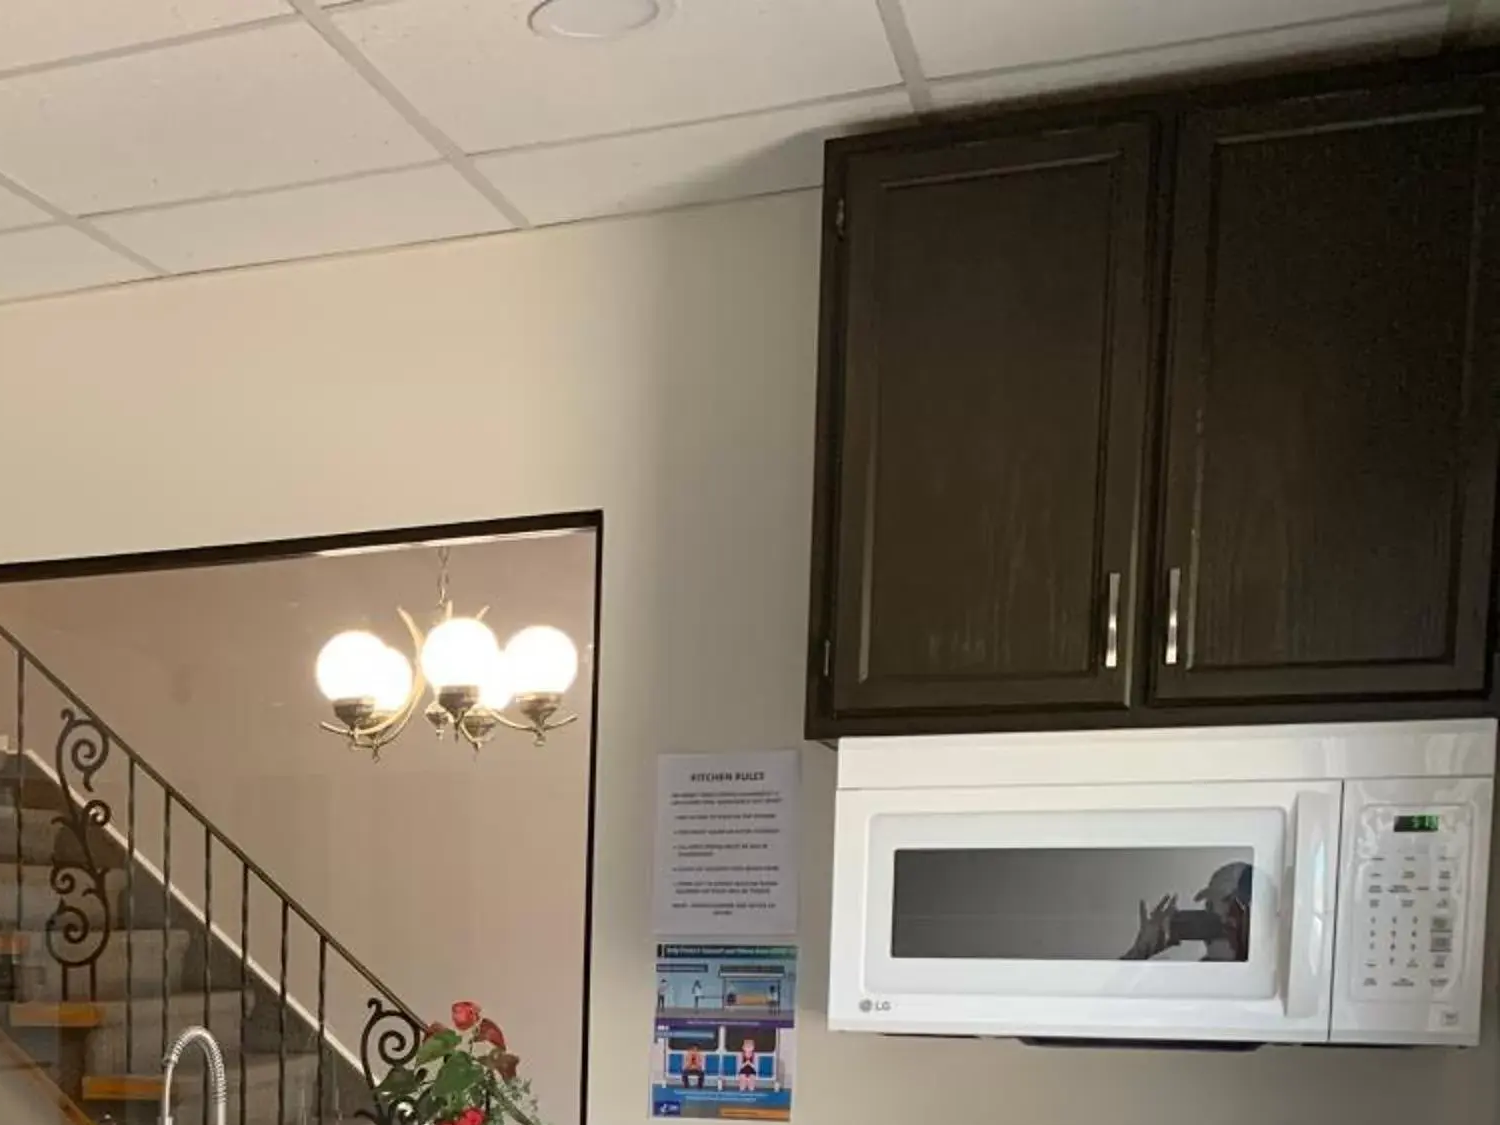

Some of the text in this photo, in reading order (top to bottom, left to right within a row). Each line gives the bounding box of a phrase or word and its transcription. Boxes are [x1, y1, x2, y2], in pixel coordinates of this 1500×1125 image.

[690, 770, 764, 782] KITCHEN RULES
[875, 1001, 892, 1011] LG
